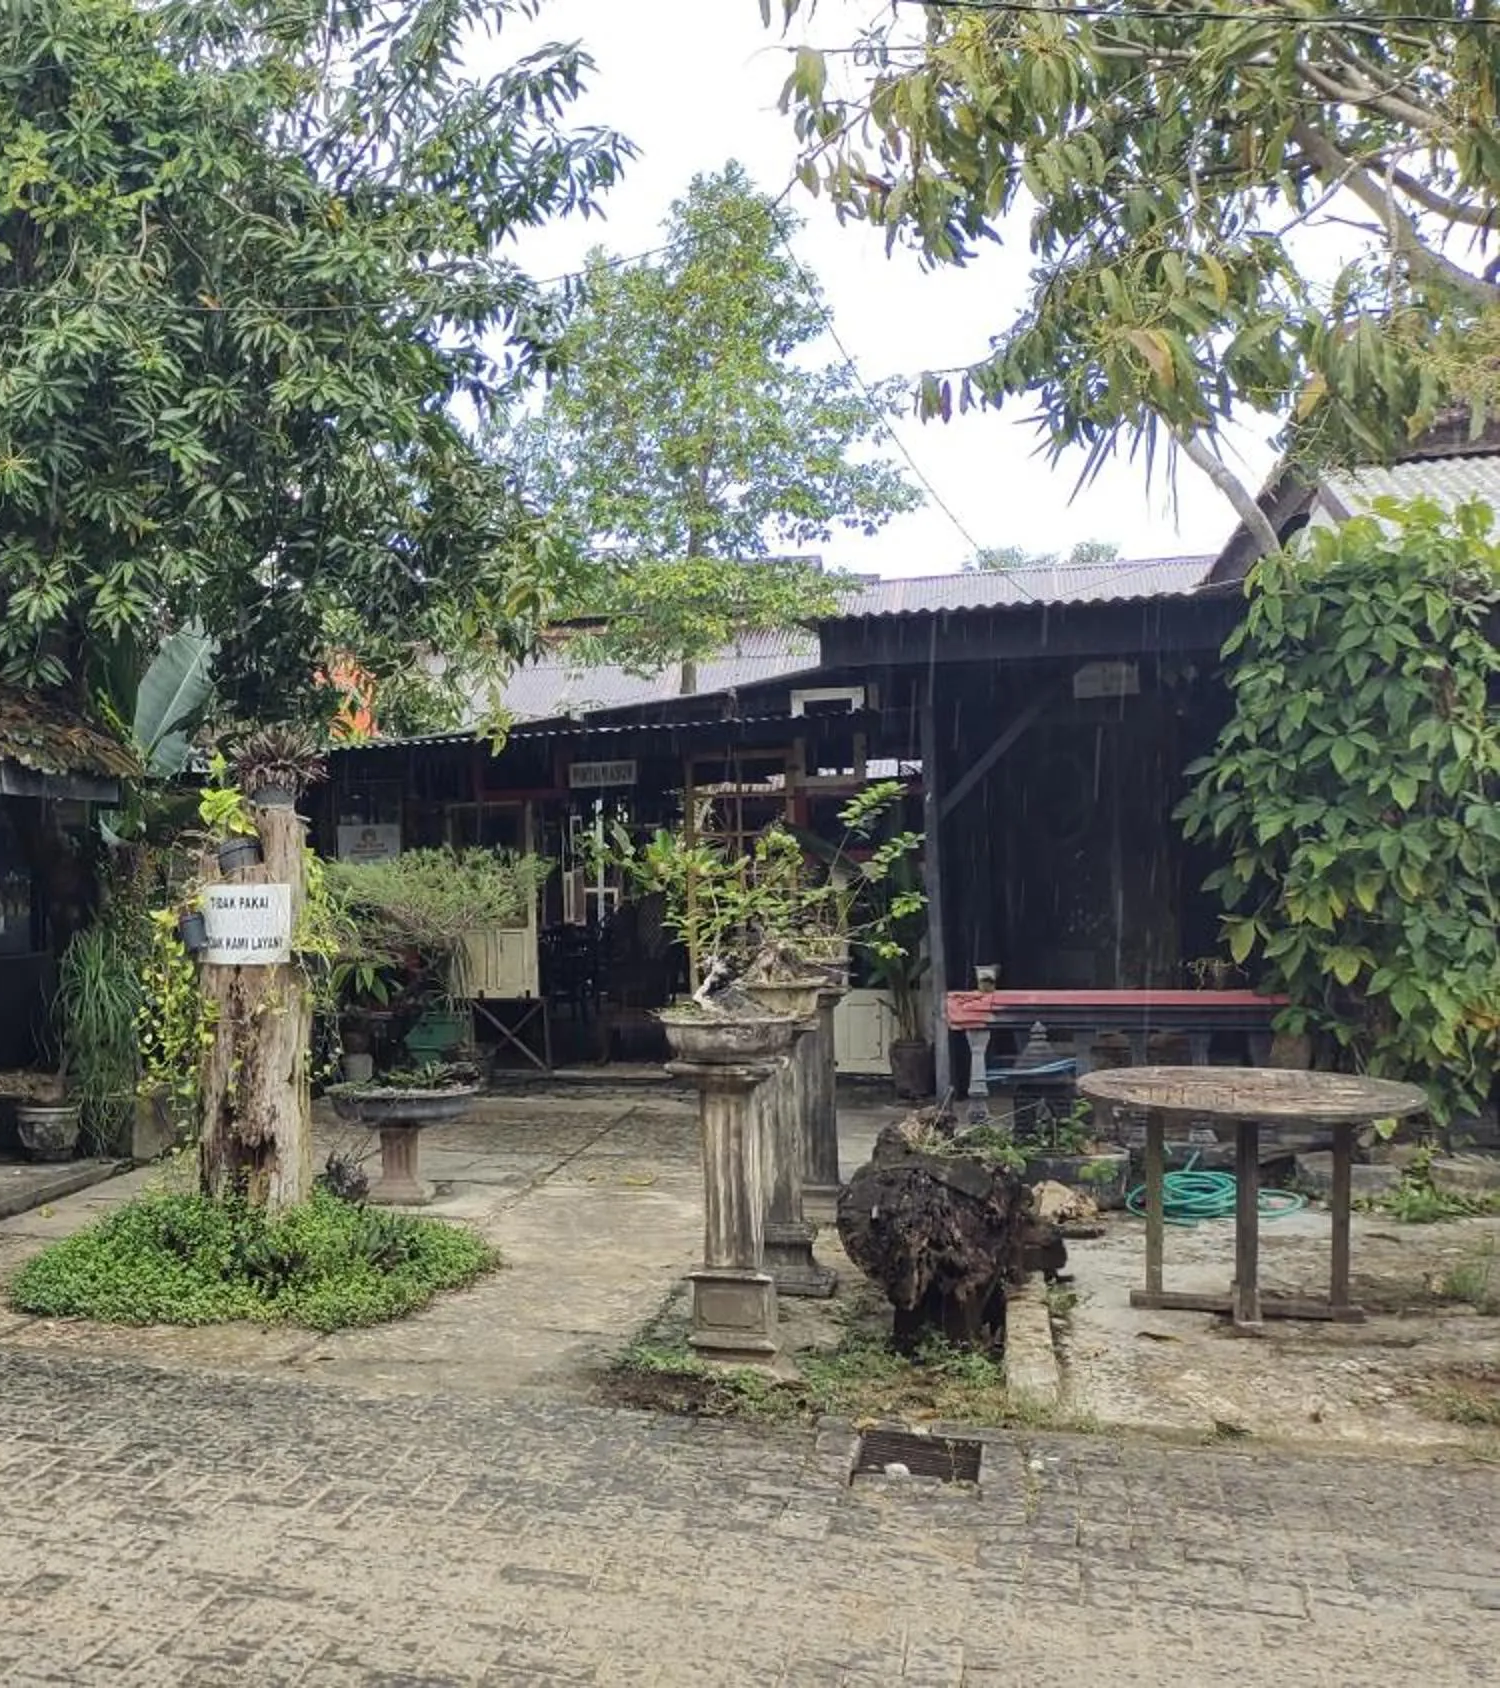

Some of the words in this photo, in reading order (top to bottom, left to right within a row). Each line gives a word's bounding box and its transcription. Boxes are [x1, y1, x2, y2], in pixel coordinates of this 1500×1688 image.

[210, 896, 236, 909] TIDAK
[239, 896, 269, 909] PAKAI
[226, 936, 249, 951] KAMI
[251, 936, 283, 950] LAYANI
